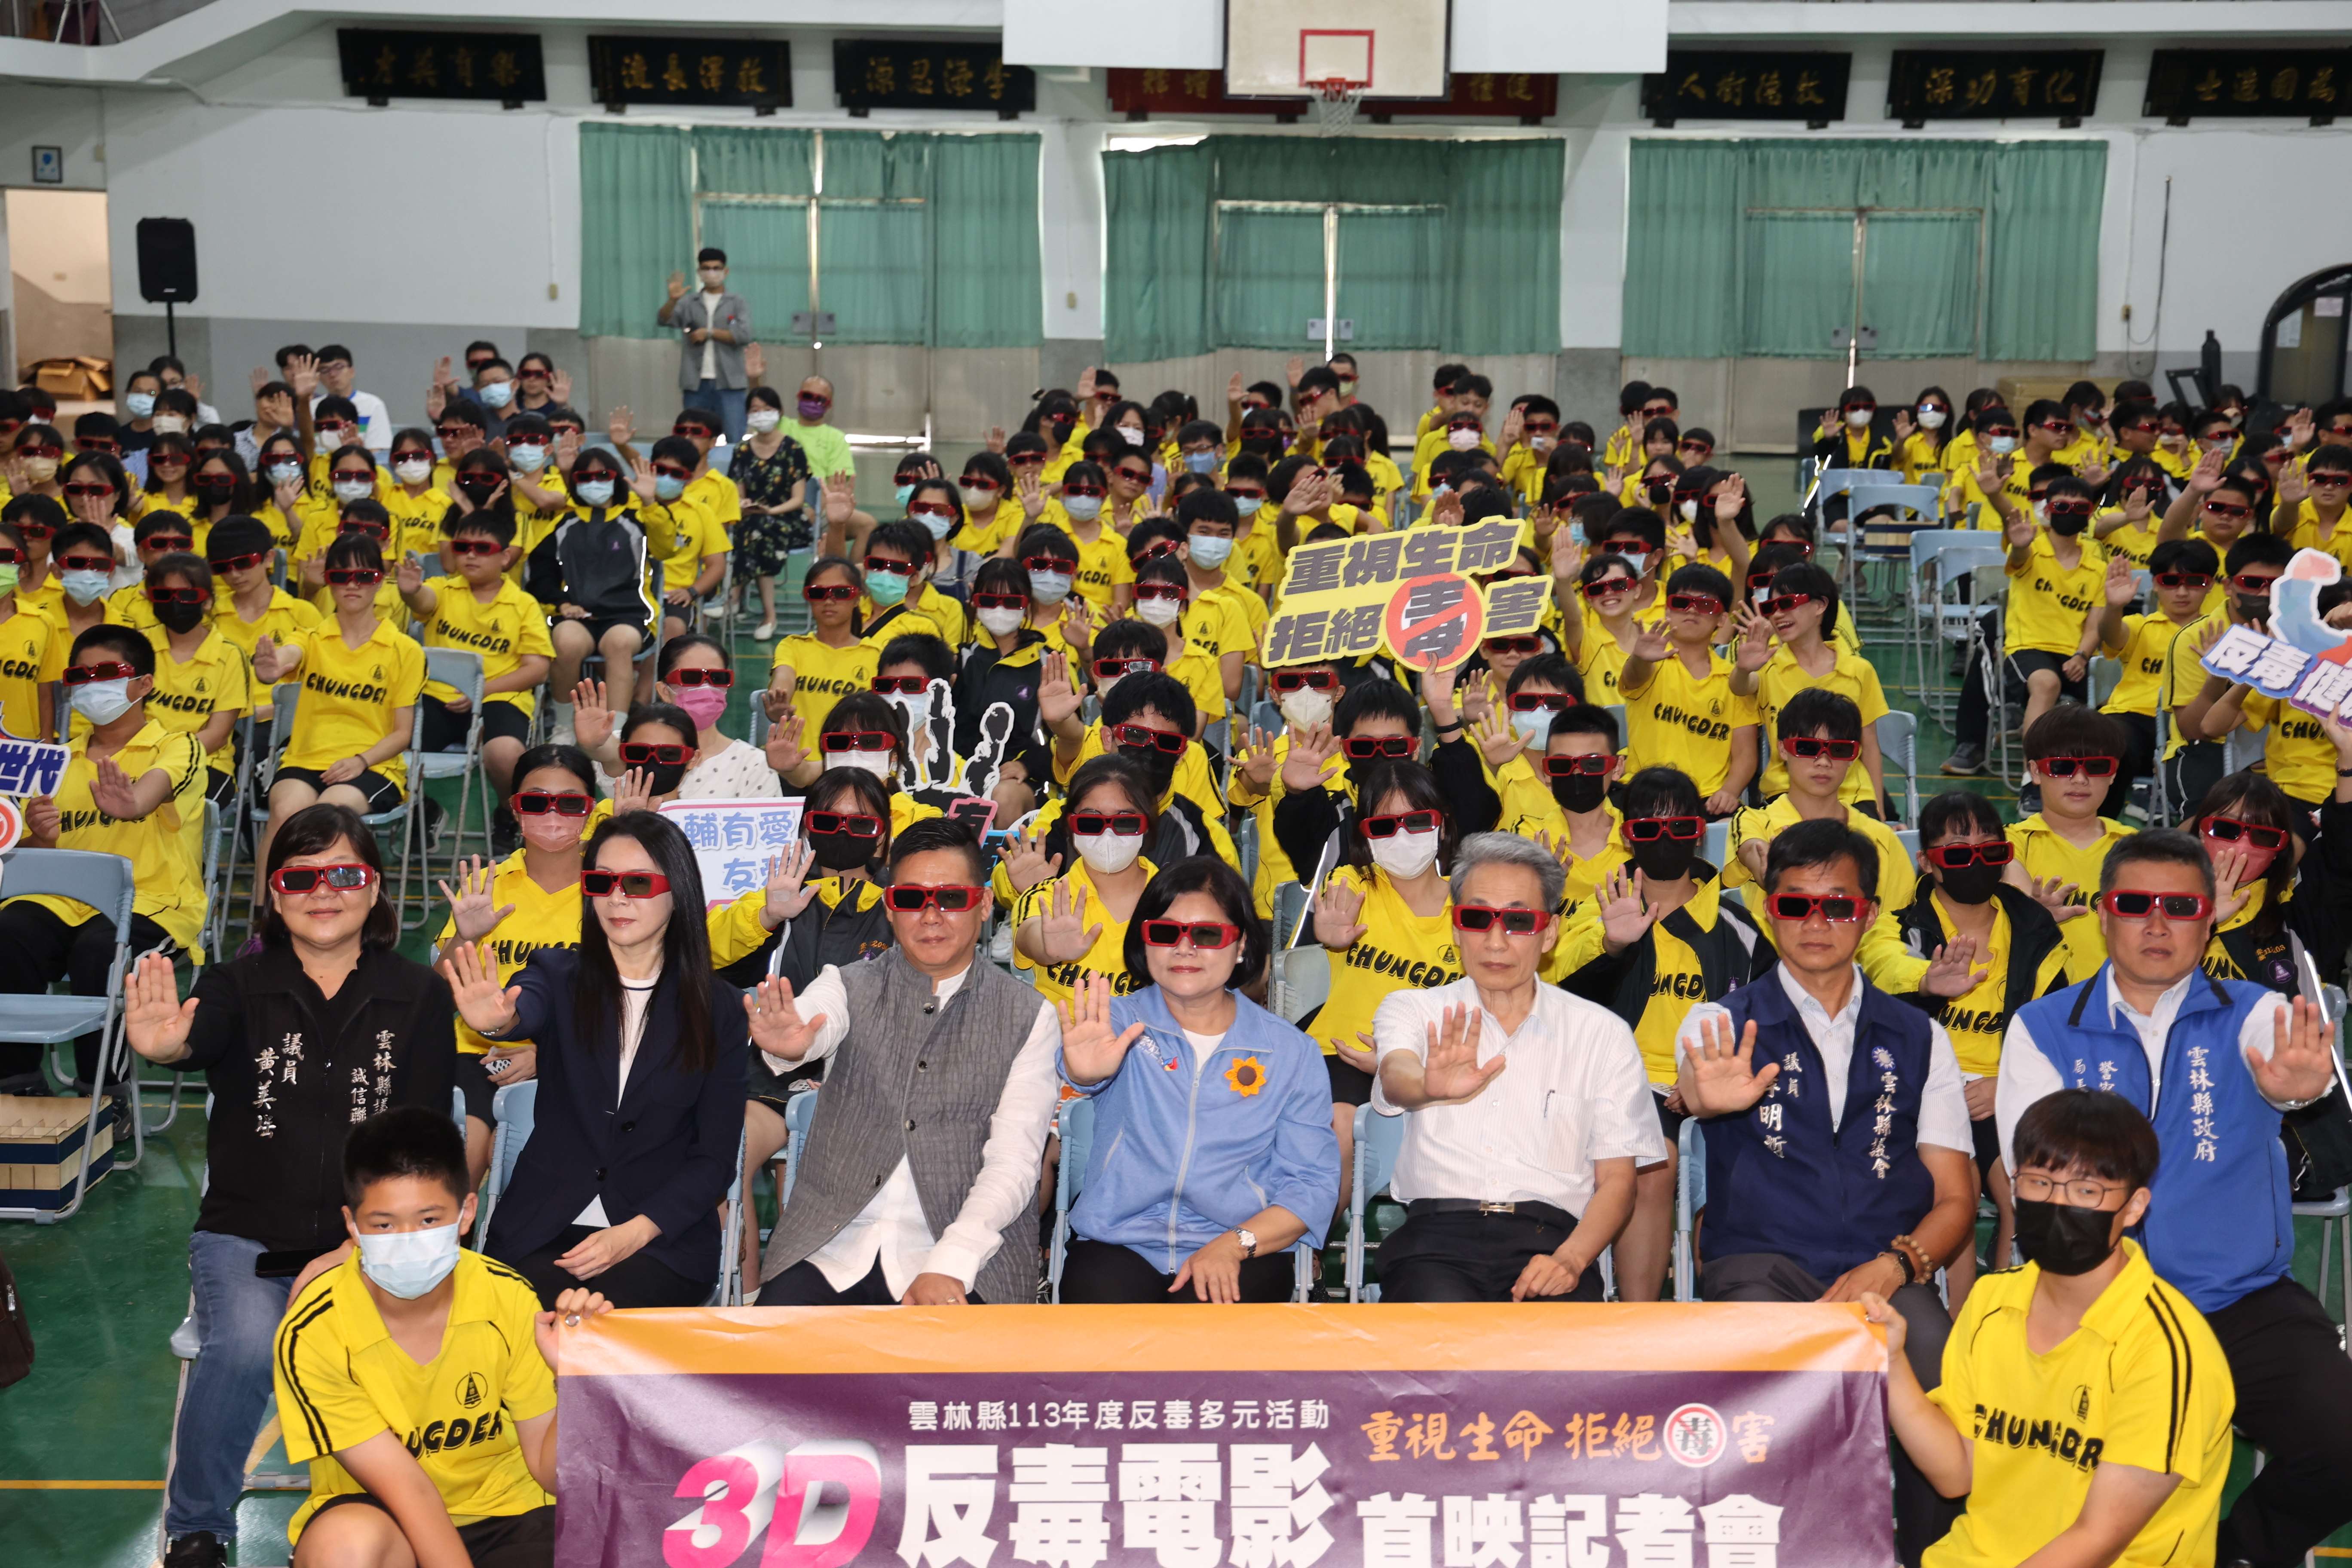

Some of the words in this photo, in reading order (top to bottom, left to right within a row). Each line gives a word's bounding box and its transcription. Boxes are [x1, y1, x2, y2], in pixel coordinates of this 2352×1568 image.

[1285, 521, 1519, 594] 重視生命
[1267, 579, 1547, 662] 拒絕毒害
[677, 810, 794, 848] 輔有愛
[281, 1032, 304, 1085] 議員
[1782, 1051, 1803, 1098] 議員
[1869, 1072, 1898, 1179] 雲林縣議會
[2187, 1046, 2220, 1162] 雲林縣政府
[908, 1400, 1329, 1431] 雲林縣113年度反毒多元活動
[1360, 1409, 1554, 1462] 重視生命
[1565, 1411, 1775, 1463] 拒絕毒害
[660, 1443, 882, 1568] 3D
[895, 1442, 1335, 1568] 反毒電影
[1357, 1491, 1785, 1568] 首映記者會
